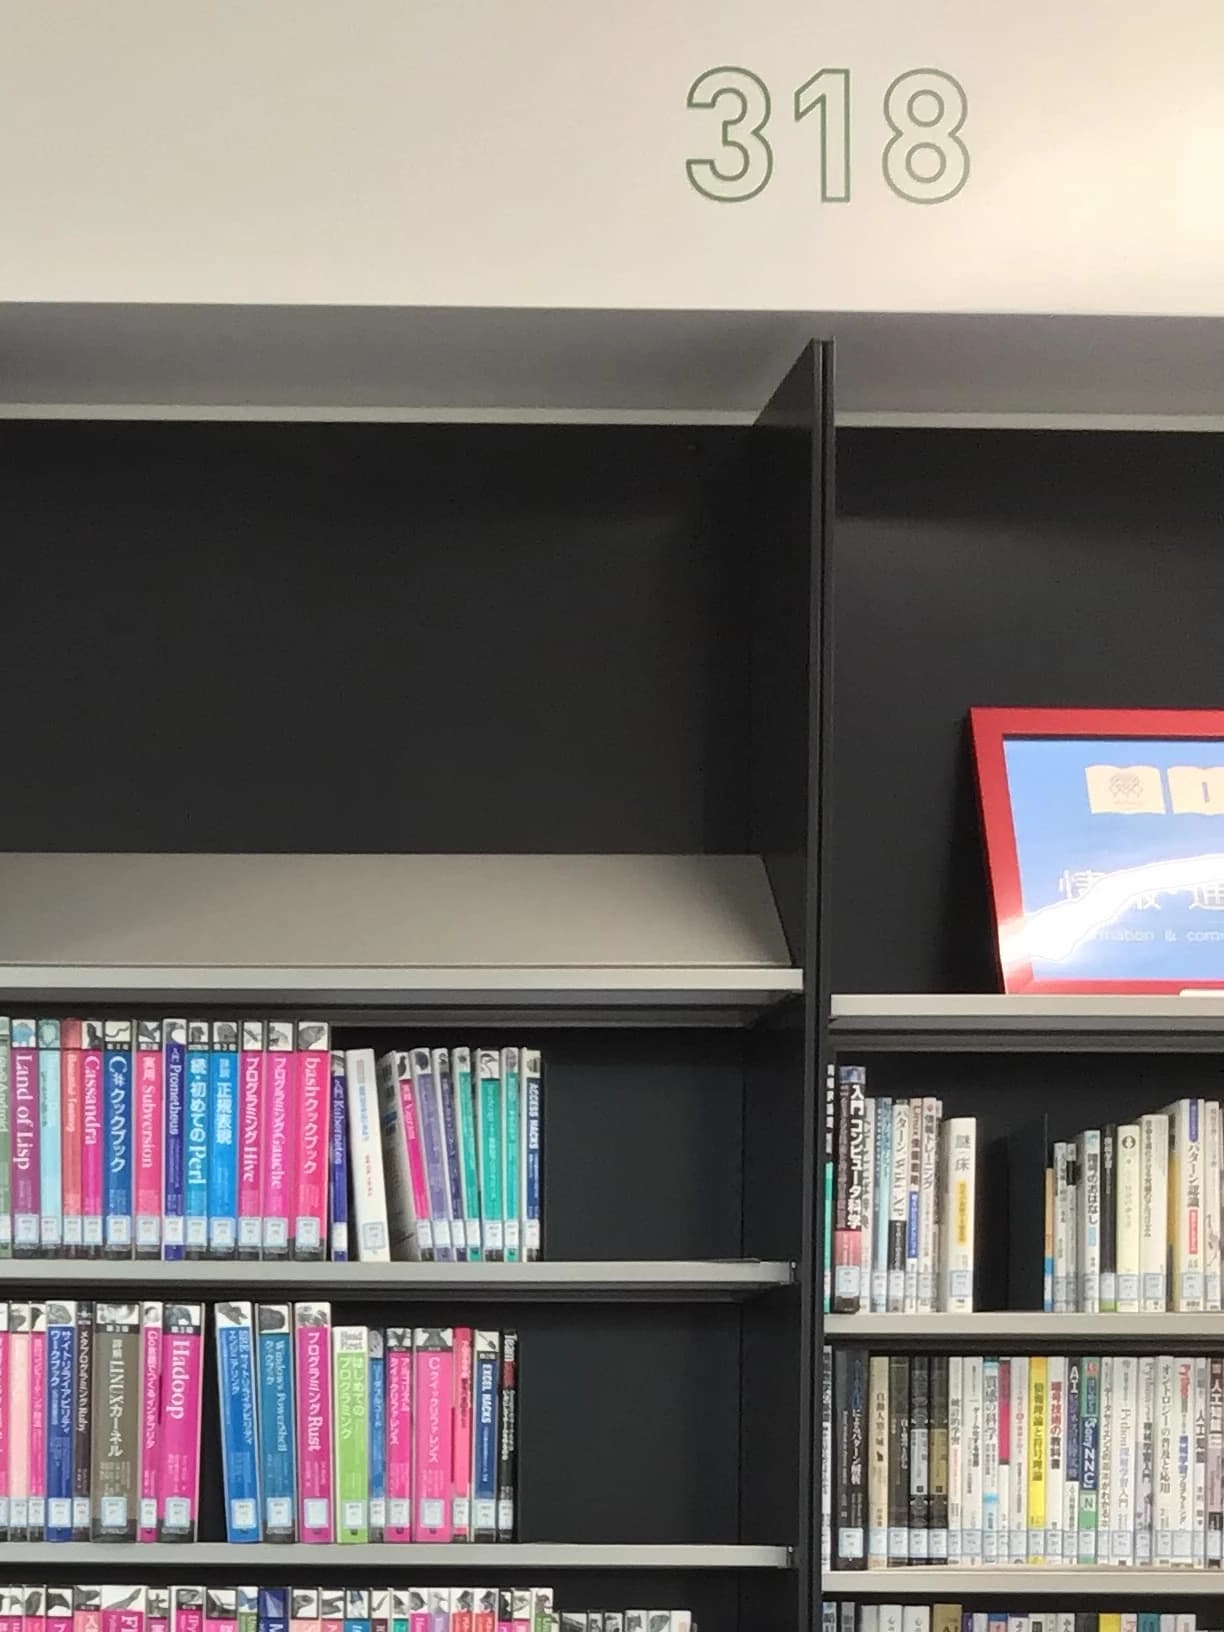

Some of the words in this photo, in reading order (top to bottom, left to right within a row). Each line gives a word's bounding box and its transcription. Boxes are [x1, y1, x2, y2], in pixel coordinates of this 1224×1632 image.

[686, 66, 970, 204] 318
[15, 1055, 33, 1099] Land
[15, 1105, 33, 1127] of
[84, 1055, 101, 1145] Cassandra
[108, 1056, 127, 1173] C#クックブック
[167, 1063, 182, 1136] Prometheus
[303, 1057, 322, 1175] bashクックブック
[850, 1084, 865, 1116] 入門
[12, 1131, 33, 1170] Lisp
[141, 1085, 155, 1168] Subversion
[847, 1119, 864, 1230] コンピュータ科学
[108, 1361, 124, 1457] LINUXカーネル
[165, 1339, 190, 1420] Hadoop
[306, 1332, 323, 1452] プログラミングRust
